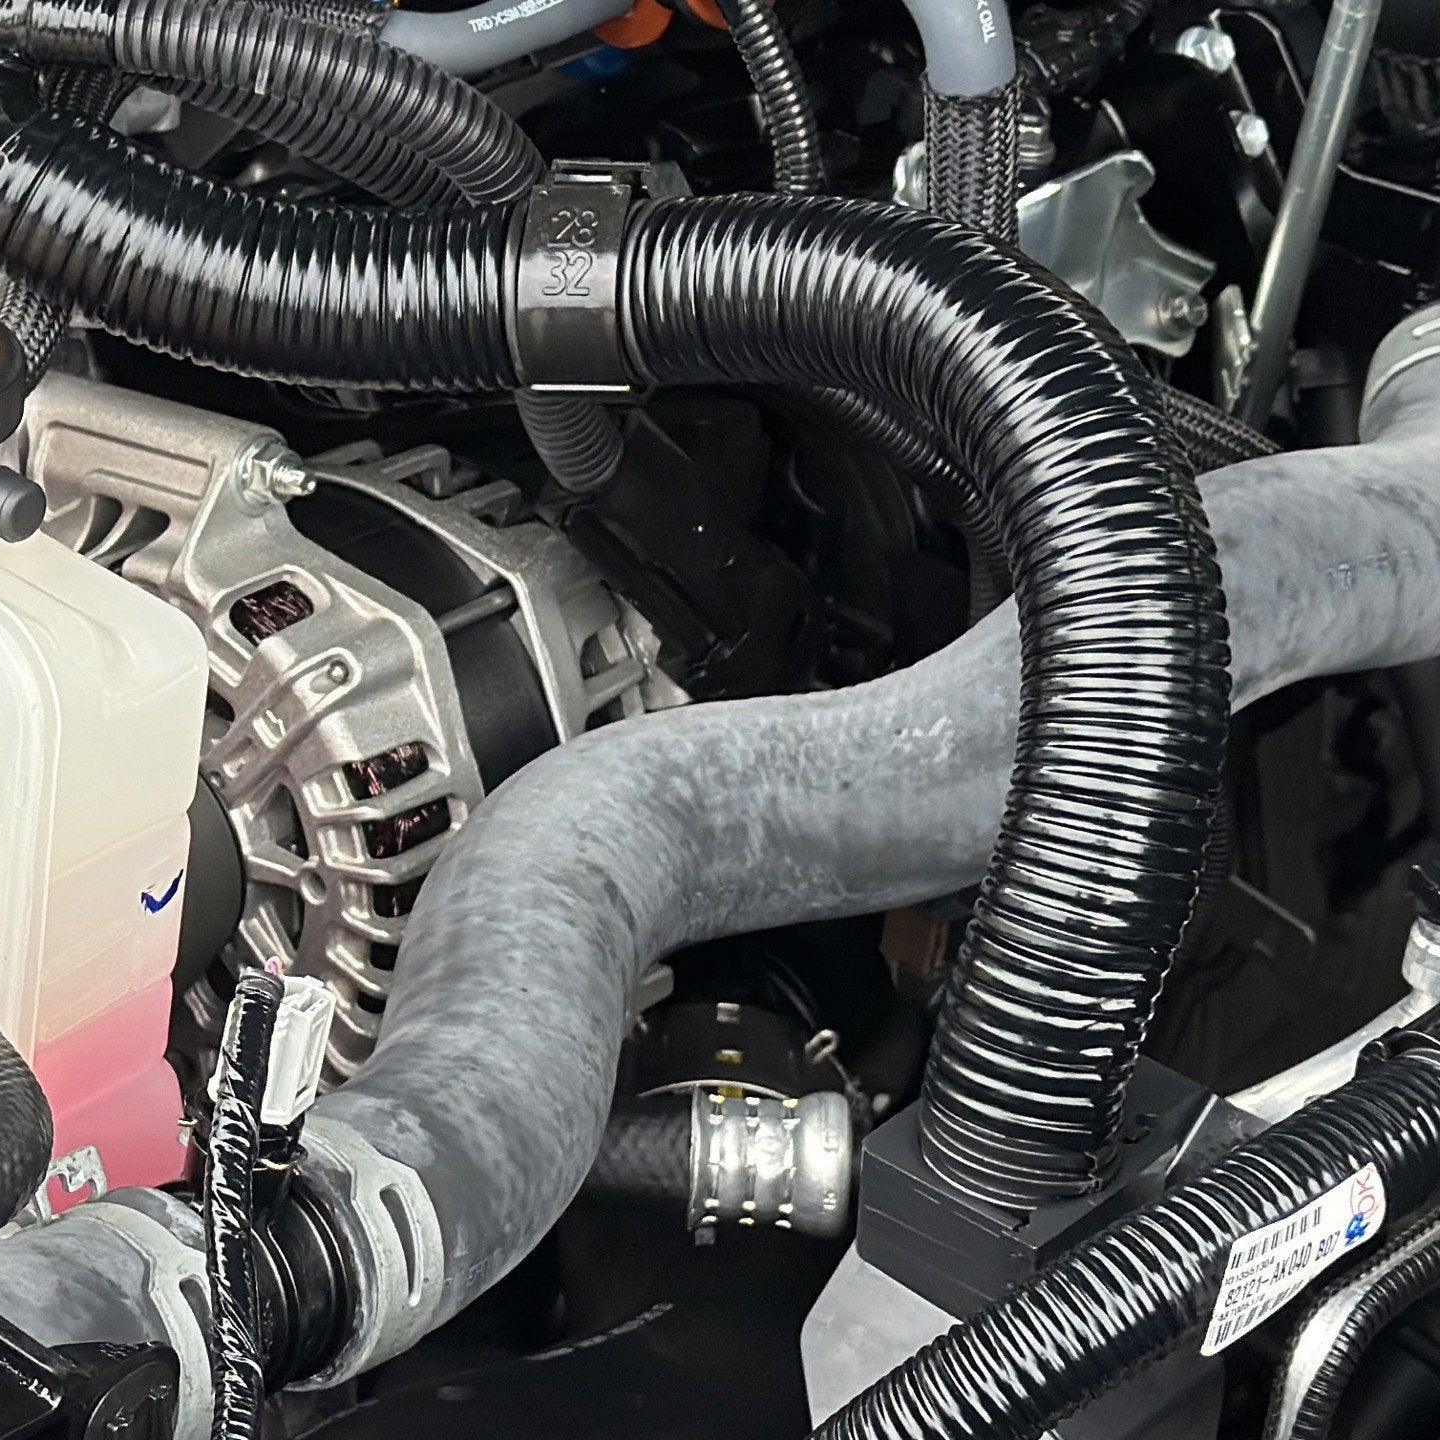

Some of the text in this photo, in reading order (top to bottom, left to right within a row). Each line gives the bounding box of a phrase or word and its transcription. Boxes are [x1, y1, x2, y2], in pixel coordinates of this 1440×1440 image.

[468, 16, 493, 32] TRD
[980, 9, 997, 44] TRD
[542, 250, 593, 296] 32
